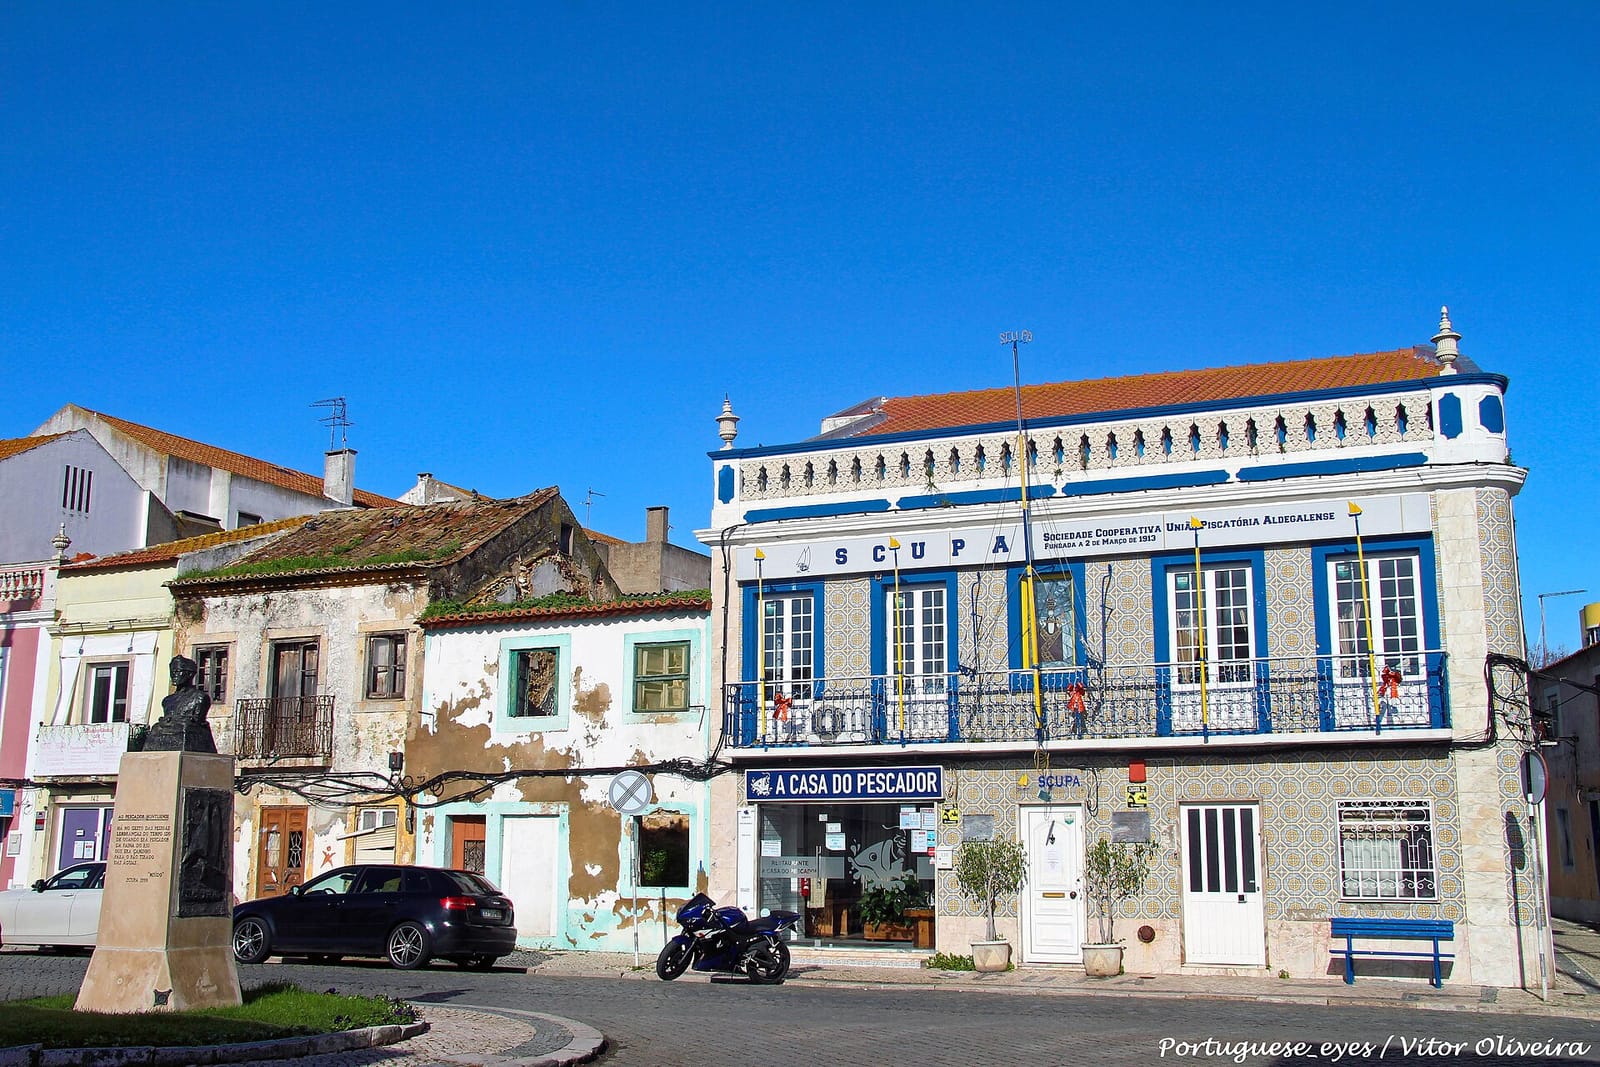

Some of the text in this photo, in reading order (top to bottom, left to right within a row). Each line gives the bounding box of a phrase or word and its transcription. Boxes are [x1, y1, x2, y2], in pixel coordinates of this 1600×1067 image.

[1085, 539, 1091, 547] 2
[1139, 534, 1156, 542] 1913
[775, 771, 938, 795] A CASA DO PESCADOR
